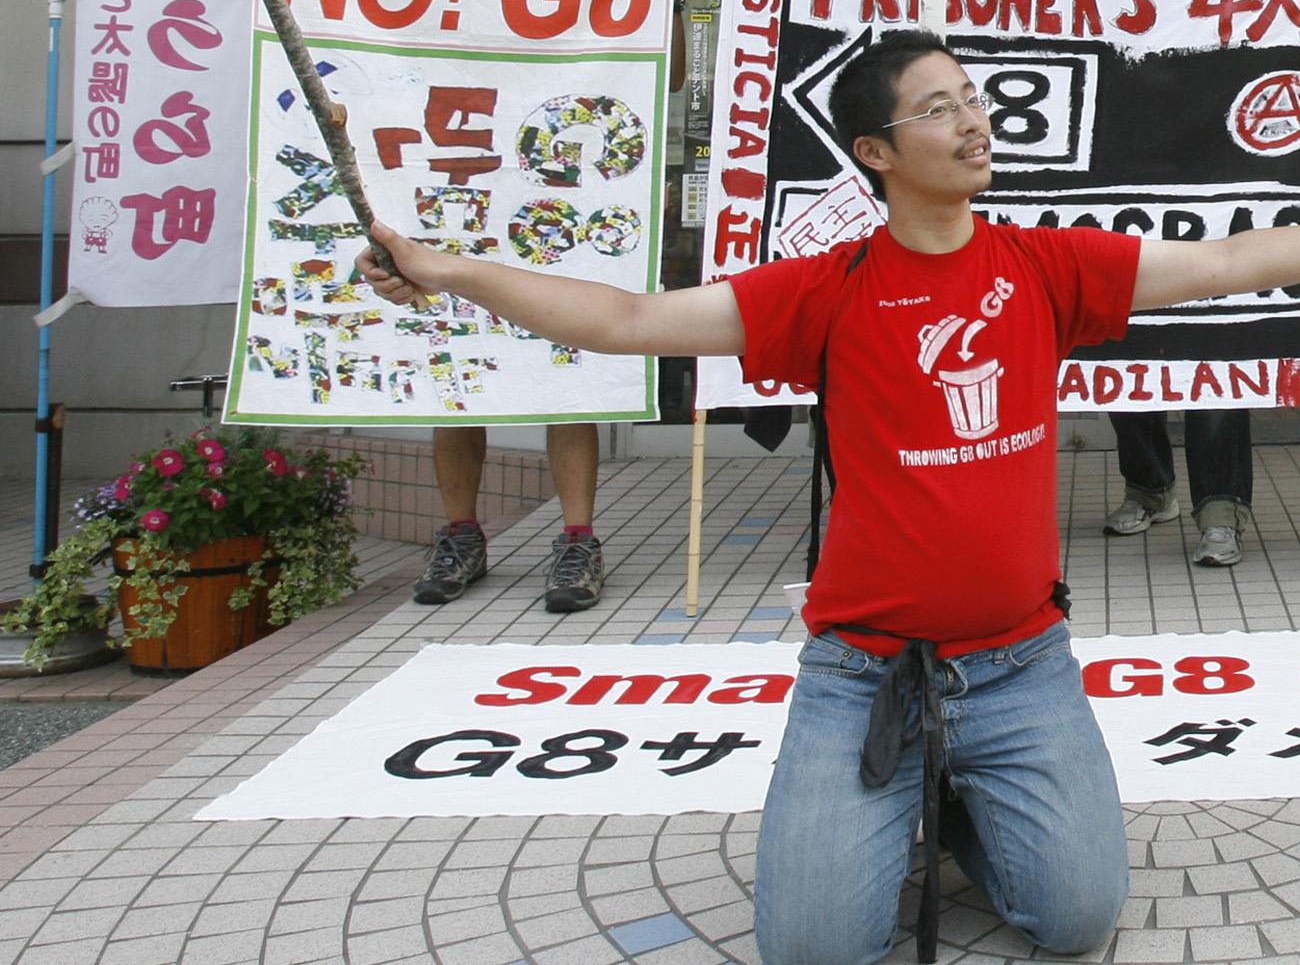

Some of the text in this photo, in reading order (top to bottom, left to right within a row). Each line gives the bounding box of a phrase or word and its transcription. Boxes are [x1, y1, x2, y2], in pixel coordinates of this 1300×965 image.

[980, 276, 1014, 318] G8
[1057, 352, 1270, 406] ADILAN
[898, 449, 957, 466] THROWING
[960, 445, 974, 463] G8
[976, 439, 998, 460] OUT
[999, 437, 1009, 455] IS
[1082, 656, 1256, 698] G8
